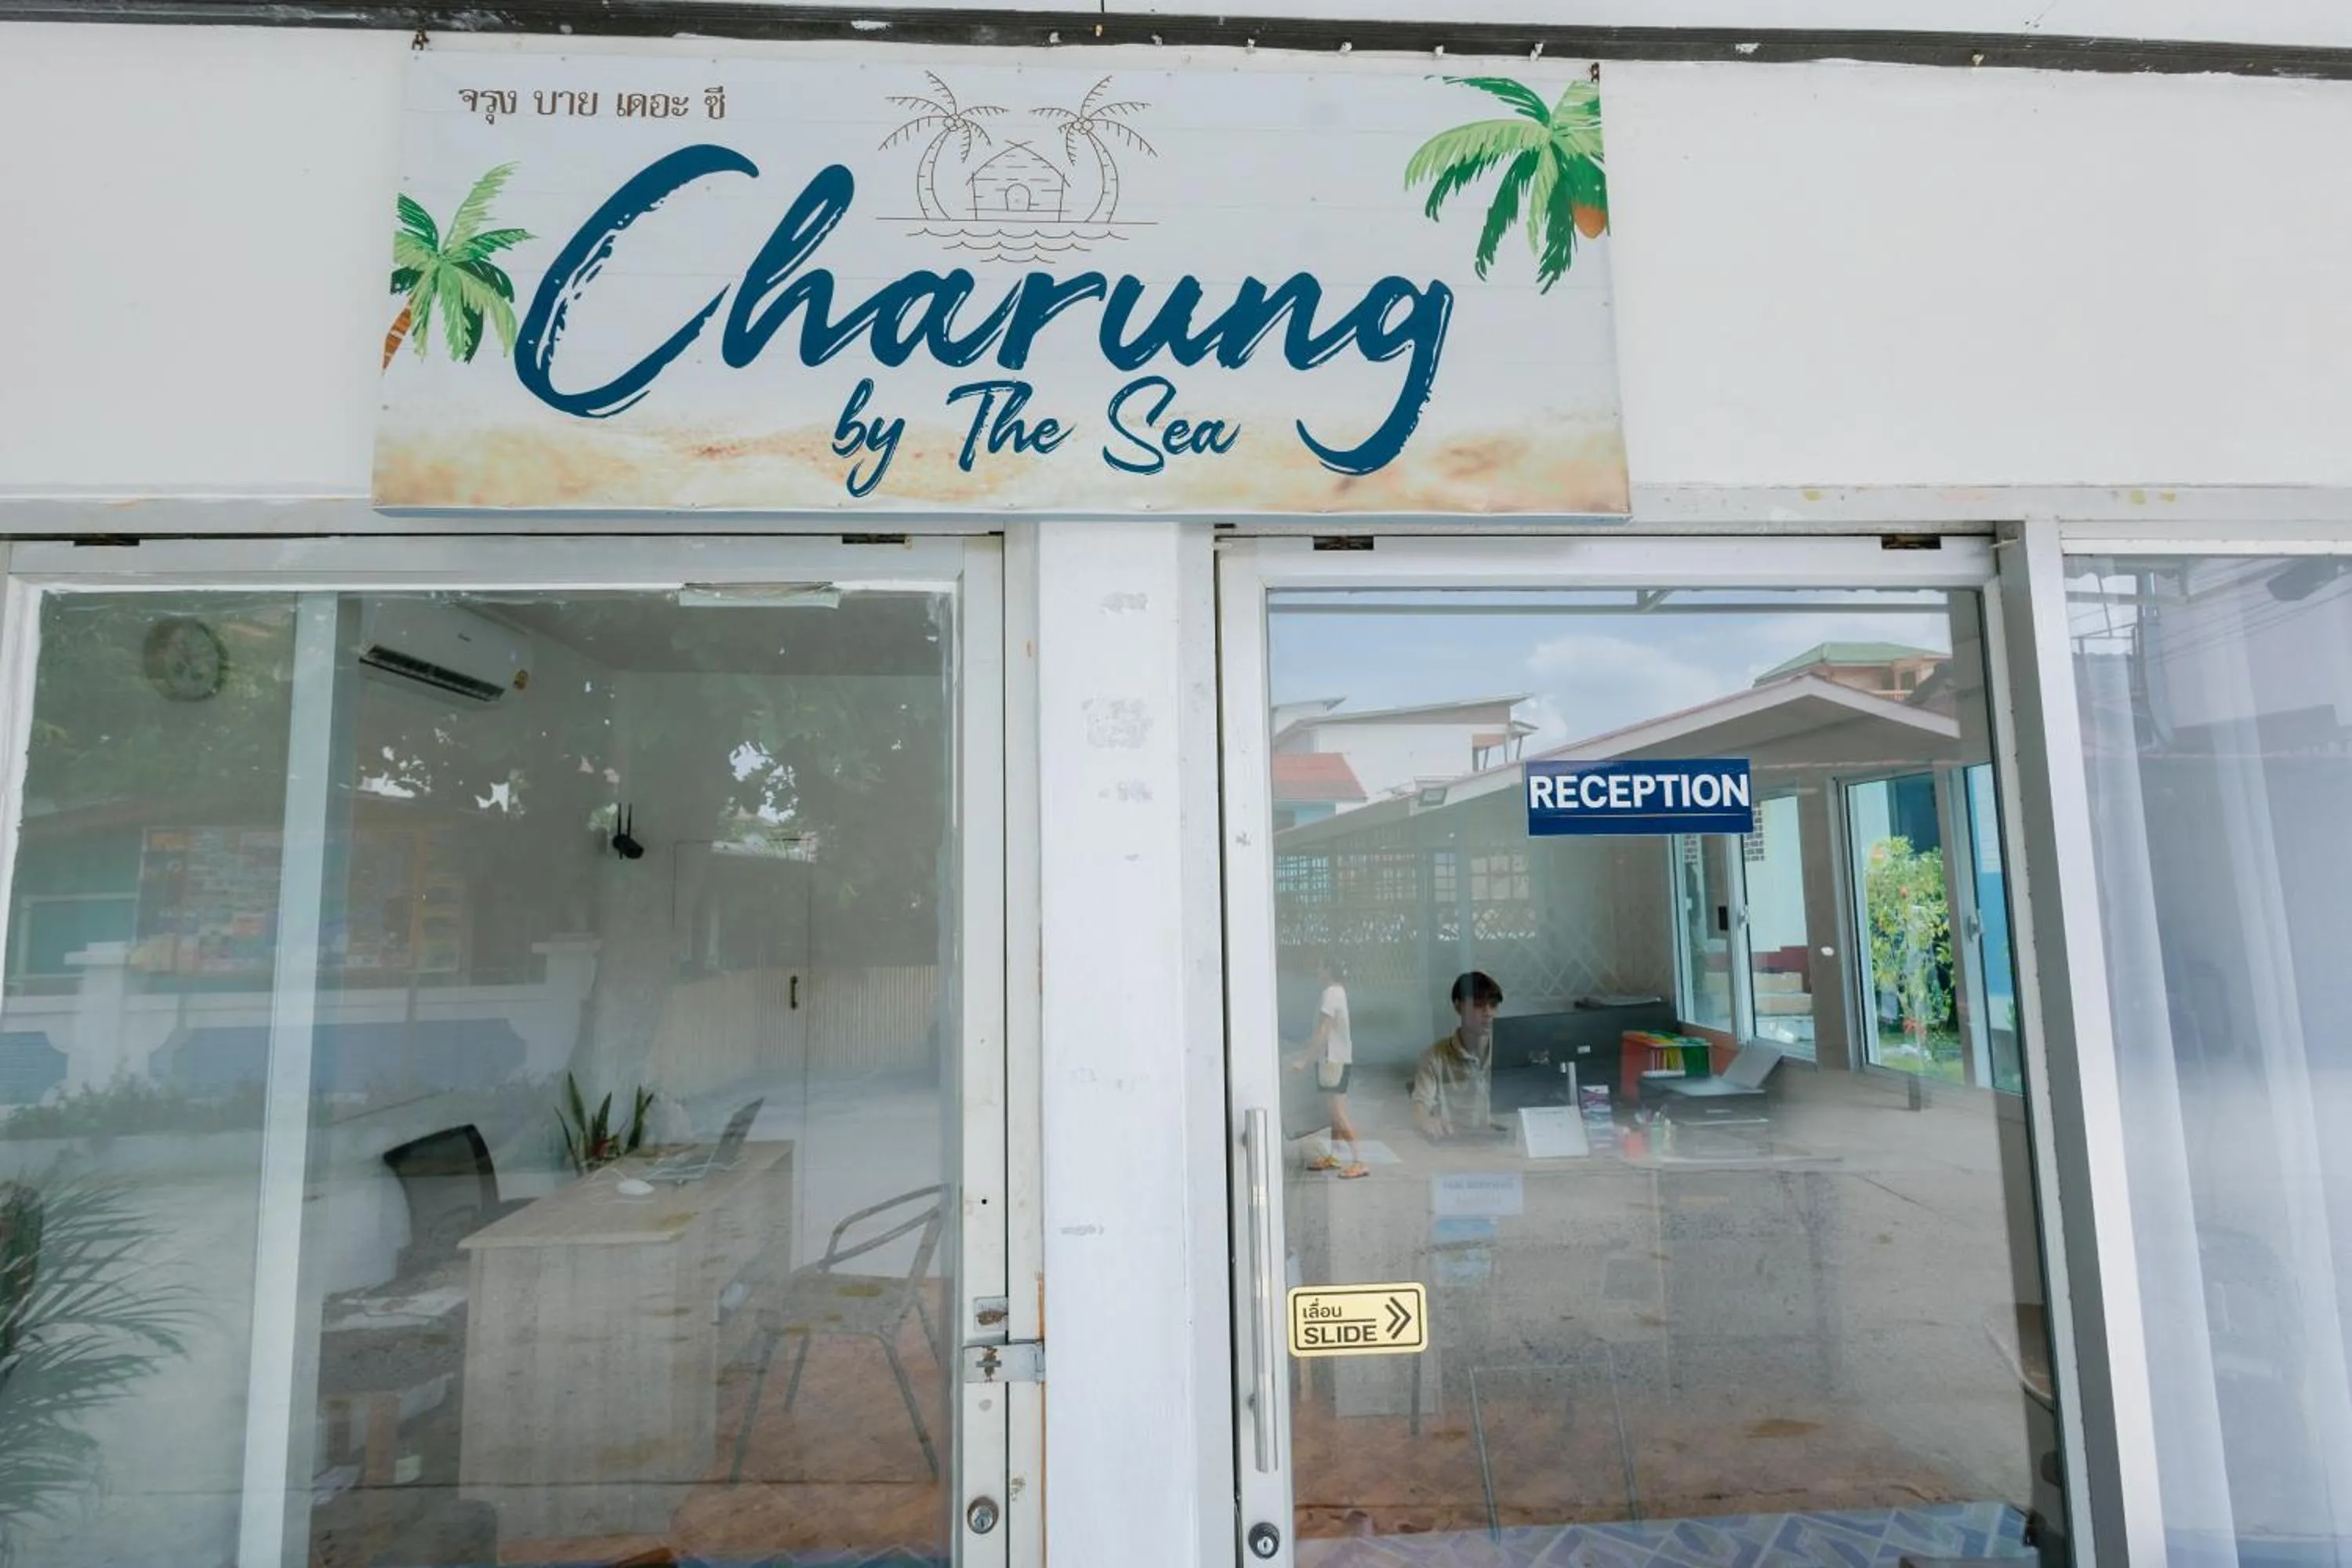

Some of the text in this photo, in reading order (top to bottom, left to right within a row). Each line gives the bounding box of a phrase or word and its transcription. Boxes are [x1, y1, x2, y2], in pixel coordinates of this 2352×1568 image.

[459, 85, 726, 125] จรุง บาย เดอะ ซี
[514, 143, 1454, 476] Charung
[832, 376, 1241, 498] by The Sea
[1530, 774, 1749, 808] RECEPTION
[1302, 1298, 1342, 1319] เลื่อน
[1304, 1324, 1378, 1345] SLIDE
